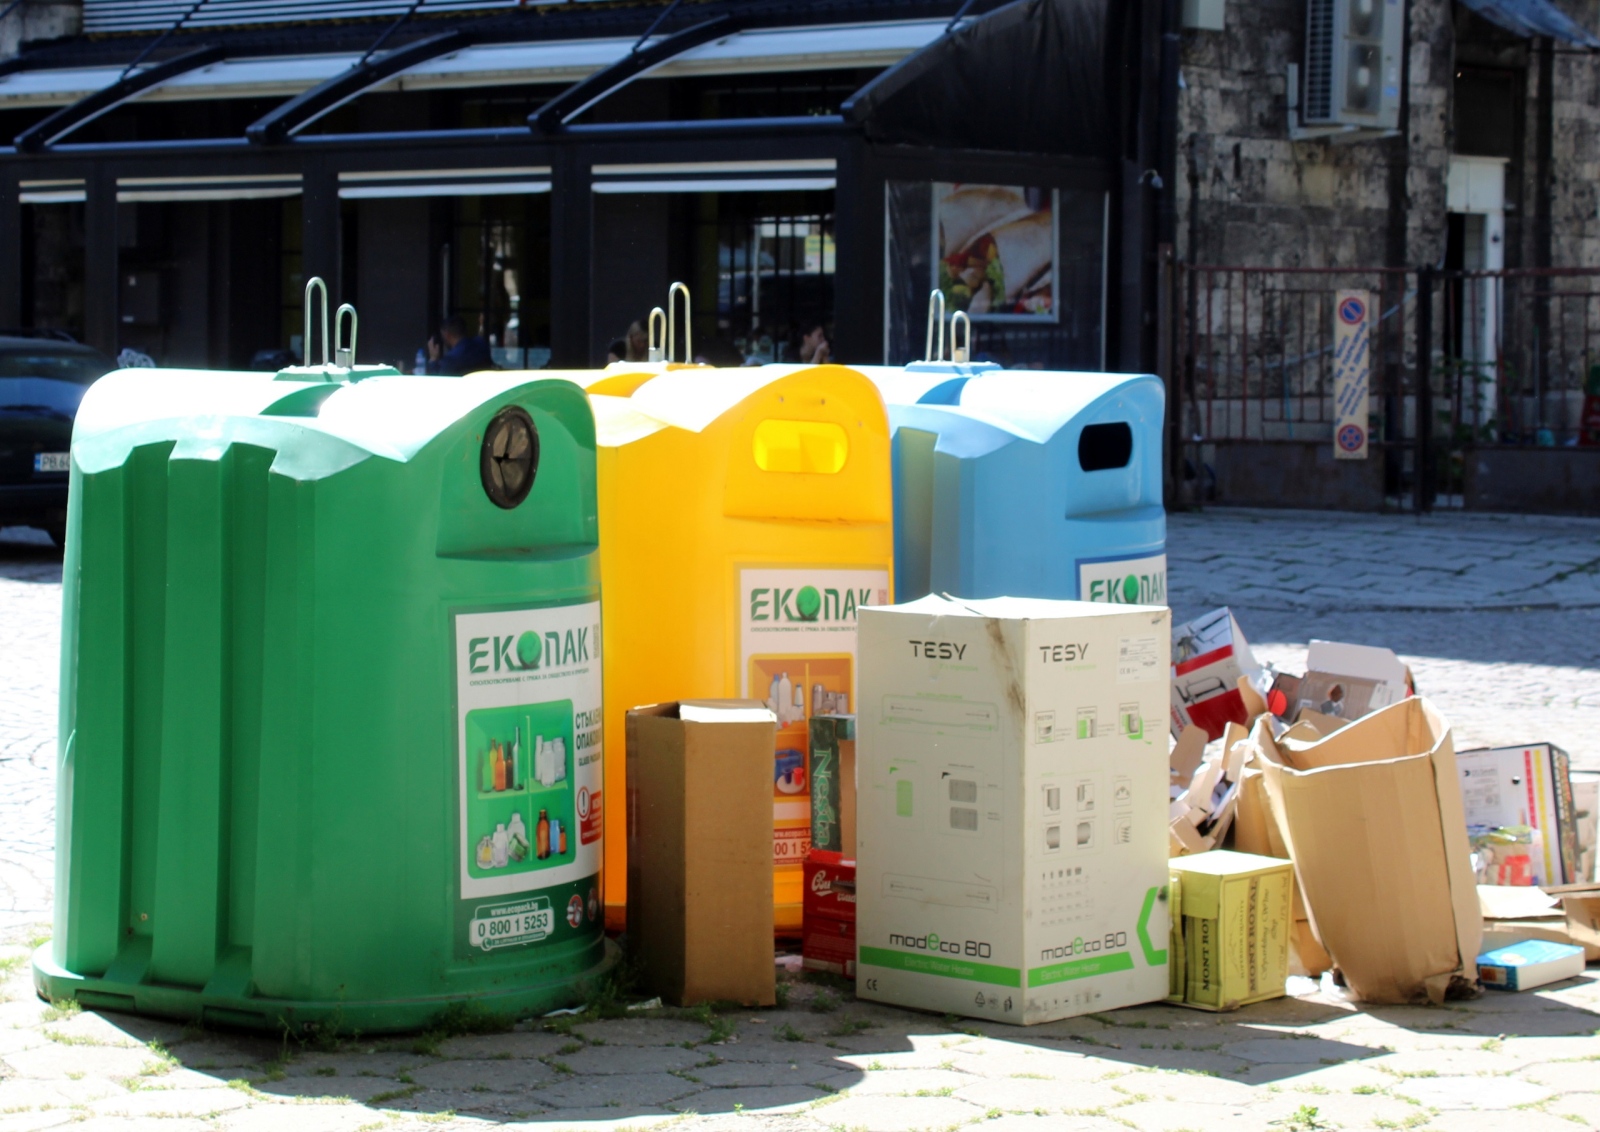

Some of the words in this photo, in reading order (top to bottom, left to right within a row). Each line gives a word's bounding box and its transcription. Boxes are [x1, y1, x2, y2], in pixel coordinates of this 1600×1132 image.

[750, 585, 871, 621] ЕКОПАК
[469, 626, 588, 673] ЕКОПАК
[909, 640, 967, 660] TESY
[1039, 642, 1089, 663] TESY
[792, 842, 797, 855] 1
[1248, 880, 1258, 937] ROYAL
[478, 923, 486, 937] 0
[489, 919, 511, 936] 800
[515, 918, 520, 931] 1
[524, 913, 548, 930] 5253
[889, 933, 960, 954] modeco
[964, 940, 991, 958] 80
[1041, 936, 1101, 961] modeco
[1104, 931, 1127, 949] 80
[1201, 947, 1210, 991] MONT
[1248, 941, 1257, 991] MONT
